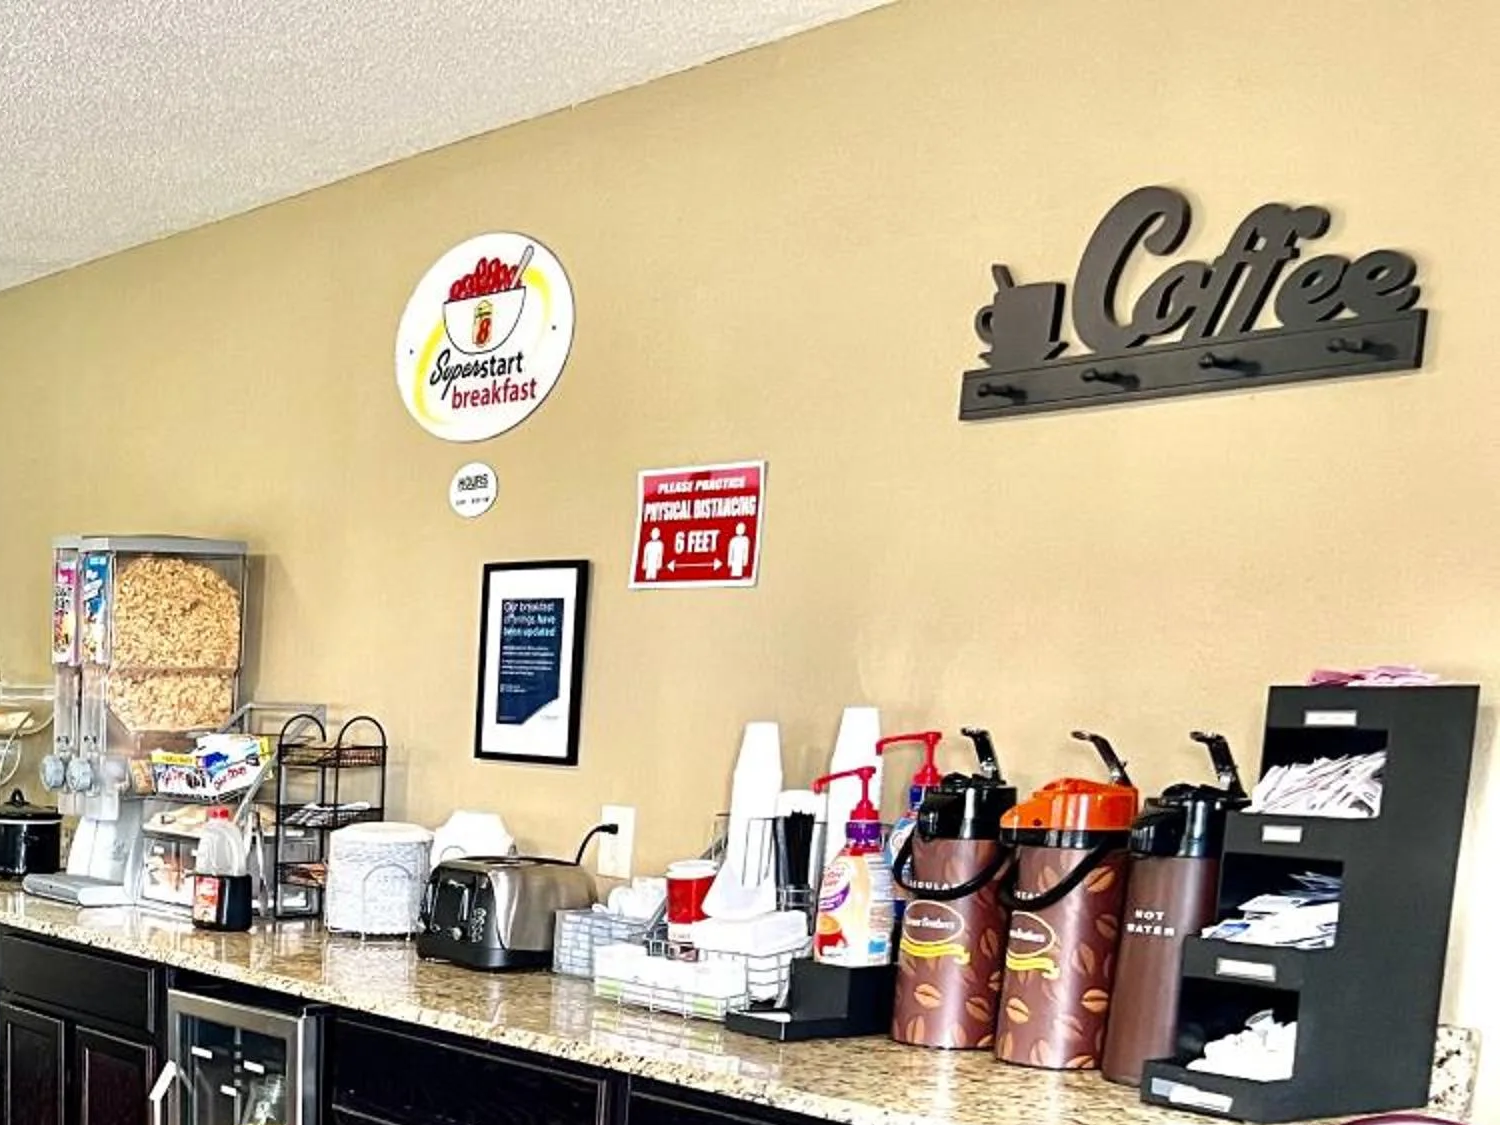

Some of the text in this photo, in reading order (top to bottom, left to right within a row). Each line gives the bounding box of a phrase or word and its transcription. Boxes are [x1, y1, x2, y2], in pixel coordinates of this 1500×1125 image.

[1072, 185, 1421, 354] Coffee
[429, 348, 524, 400] Superstart
[451, 377, 539, 409] breakfast
[657, 476, 746, 495] PLEASE PRACTICE
[643, 495, 757, 523] PHYSICAL DISTANCING
[674, 529, 720, 554] 6 FEET
[1135, 909, 1165, 921] HOT
